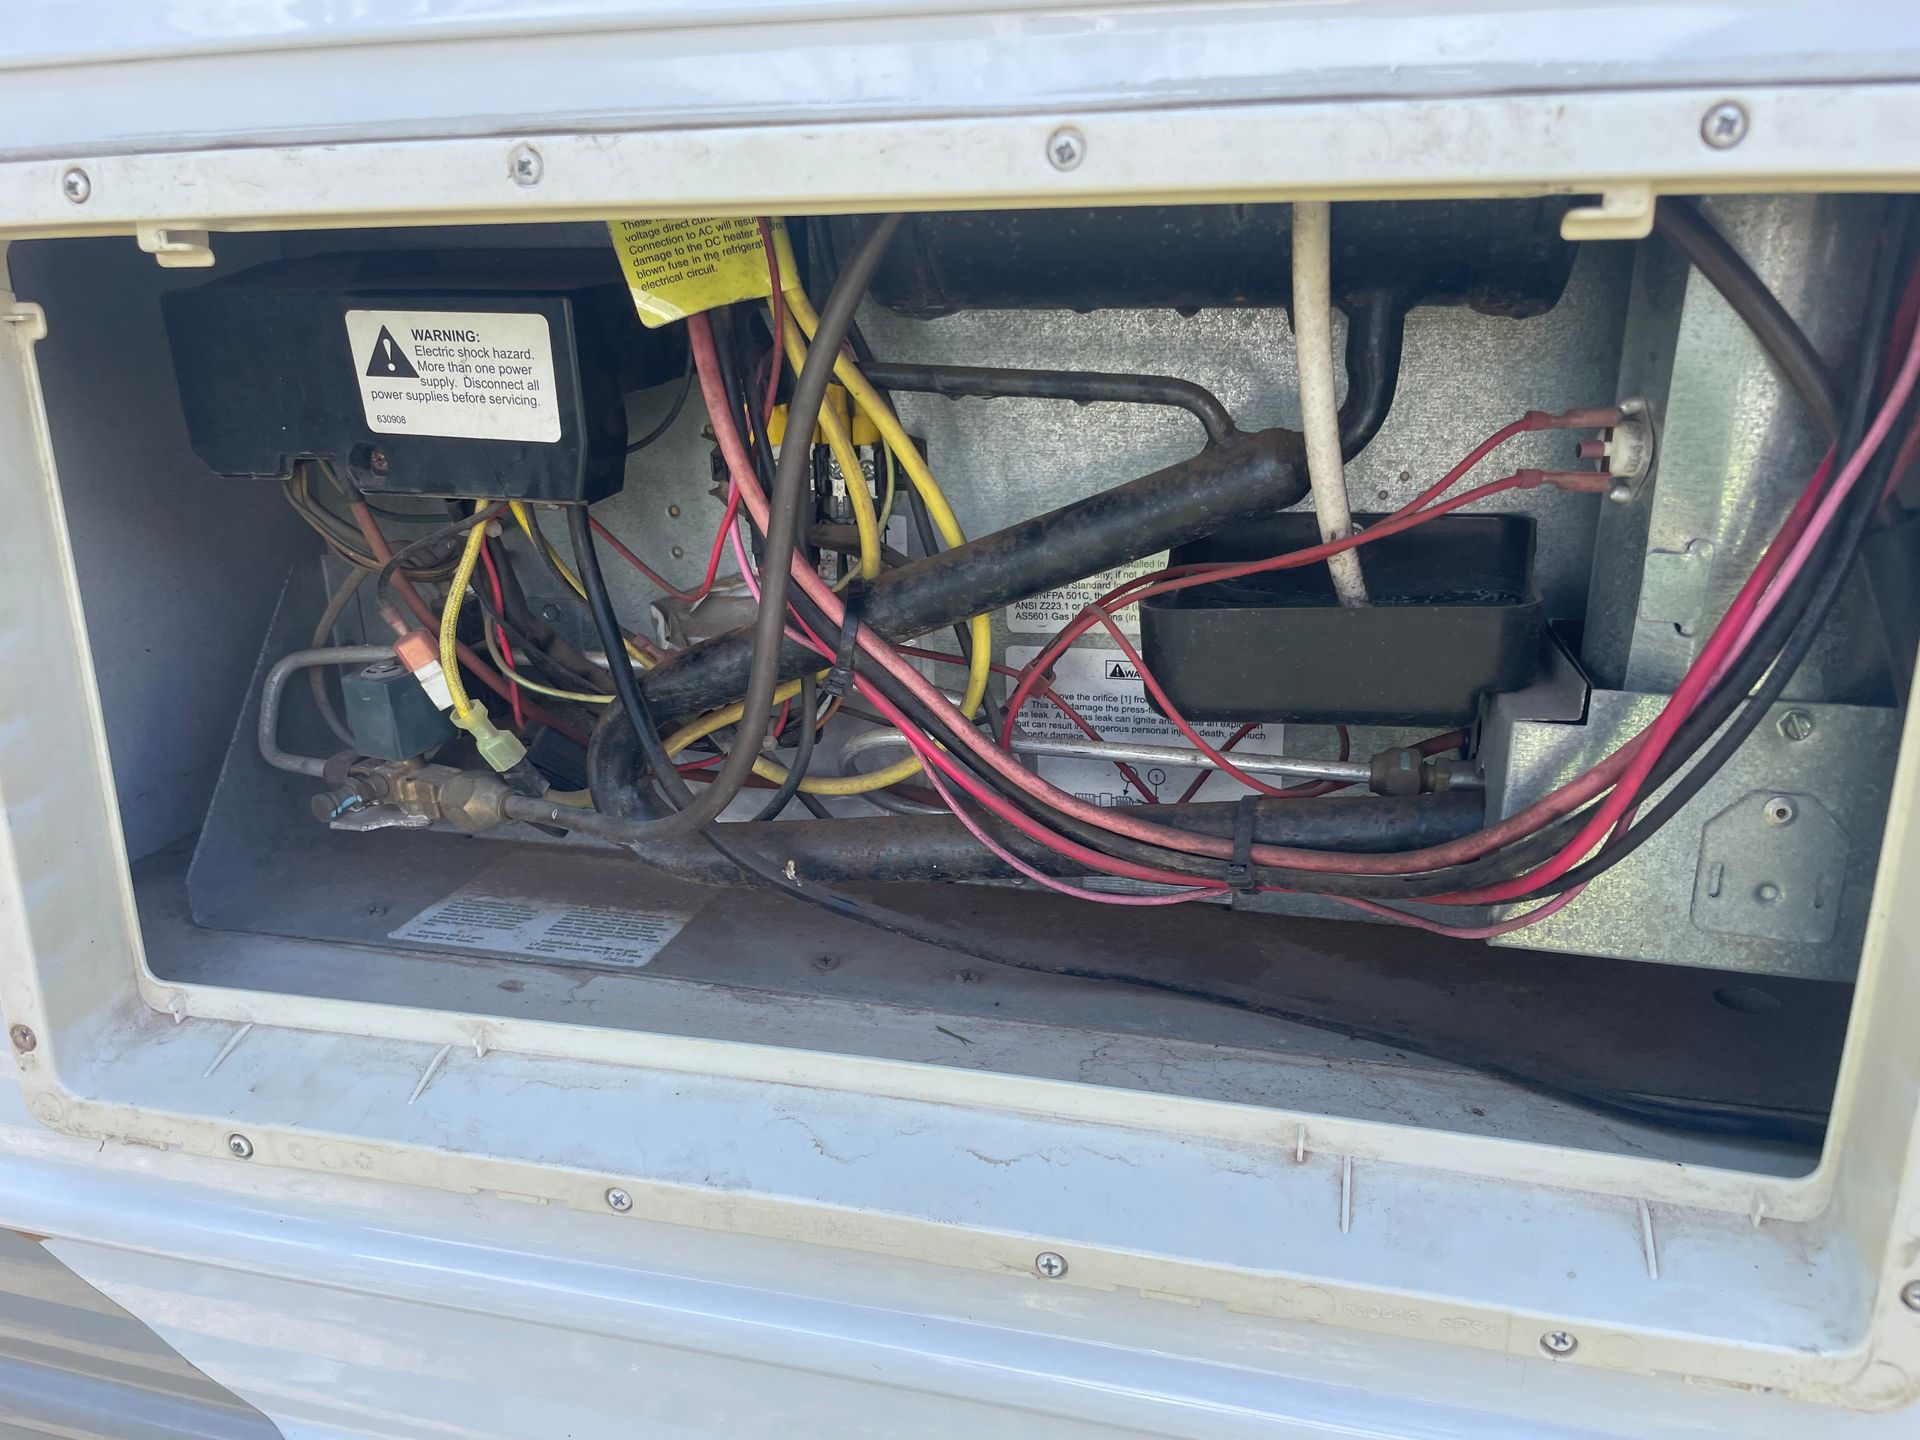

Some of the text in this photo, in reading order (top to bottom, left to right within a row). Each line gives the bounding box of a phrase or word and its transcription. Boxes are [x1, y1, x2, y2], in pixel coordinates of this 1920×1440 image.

[621, 219, 652, 231] These
[625, 228, 660, 243] voltage
[662, 219, 690, 233] direct
[629, 235, 684, 255] Connection
[686, 231, 696, 240] to
[698, 225, 714, 237] AC
[715, 220, 732, 232] will
[633, 250, 673, 268] damage
[674, 247, 685, 256] to
[687, 242, 703, 253] the
[704, 236, 721, 248] DC
[723, 229, 753, 242] heater
[636, 238, 765, 279] blown fuse in the refrigerat
[641, 264, 719, 291] electrical circuit.
[411, 328, 481, 343] WARNING:
[414, 345, 535, 360] Electric shock hazard.
[417, 360, 533, 379] More than one power
[420, 377, 540, 391] supply. Disconnect all
[371, 390, 541, 408] power supplies before servicing.
[376, 414, 407, 424] 630908
[1157, 560, 1165, 568] in
[1115, 571, 1121, 579] if
[1071, 582, 1111, 590] Standard
[1066, 592, 1092, 600] 501C,
[1014, 602, 1037, 610] ANSI
[1039, 602, 1069, 610] Z223.1
[1015, 612, 1048, 620] AS5601
[1051, 612, 1069, 620] Gas
[1125, 613, 1137, 623] (in
[1076, 693, 1091, 701] the
[1092, 694, 1118, 703] orifice
[1120, 695, 1132, 704] [1]
[1133, 695, 1146, 704] fro
[1031, 700, 1049, 709] This
[1107, 704, 1120, 712] the
[1095, 714, 1113, 722] leak
[1133, 715, 1157, 725] ignite
[1016, 720, 1030, 728] hat
[1048, 722, 1073, 730] result
[1091, 724, 1130, 733] angerous
[1131, 726, 1169, 735] personal
[1199, 729, 1227, 739] death,
